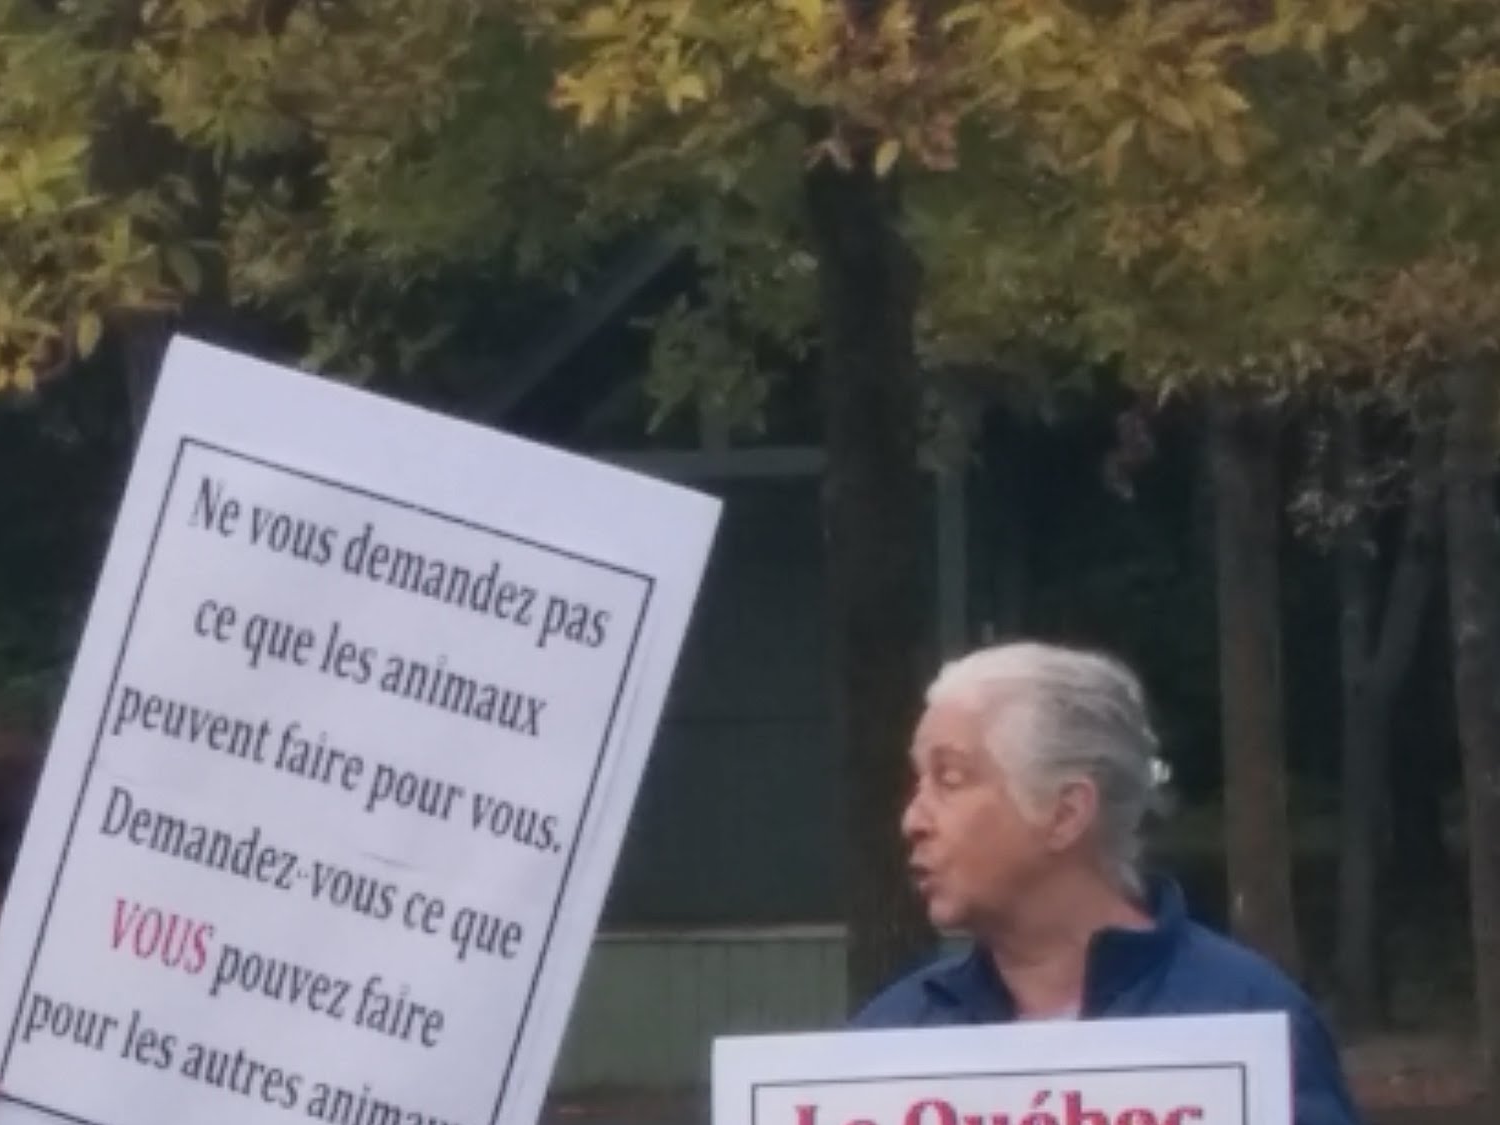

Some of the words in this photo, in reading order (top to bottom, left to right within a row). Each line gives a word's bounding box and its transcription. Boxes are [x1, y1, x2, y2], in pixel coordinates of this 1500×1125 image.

[191, 477, 240, 537] Ne
[251, 507, 337, 566] vous
[342, 523, 536, 626] demandez
[536, 596, 608, 648] pas
[195, 600, 236, 642] ce
[243, 615, 315, 669] que
[320, 622, 372, 684] les
[380, 657, 546, 736] animaux
[112, 686, 270, 763] peuvent
[275, 724, 363, 791] faire
[366, 764, 464, 820] pour
[472, 793, 561, 853] vous.
[100, 786, 396, 919] Demandez-vous
[403, 893, 444, 934] ce
[451, 908, 522, 960] que
[22, 994, 118, 1050] pour
[121, 1011, 176, 1069] les
[180, 1043, 302, 1109] autres
[109, 899, 214, 973] VOUS
[209, 944, 351, 1019] pouvez
[355, 976, 444, 1047] faire
